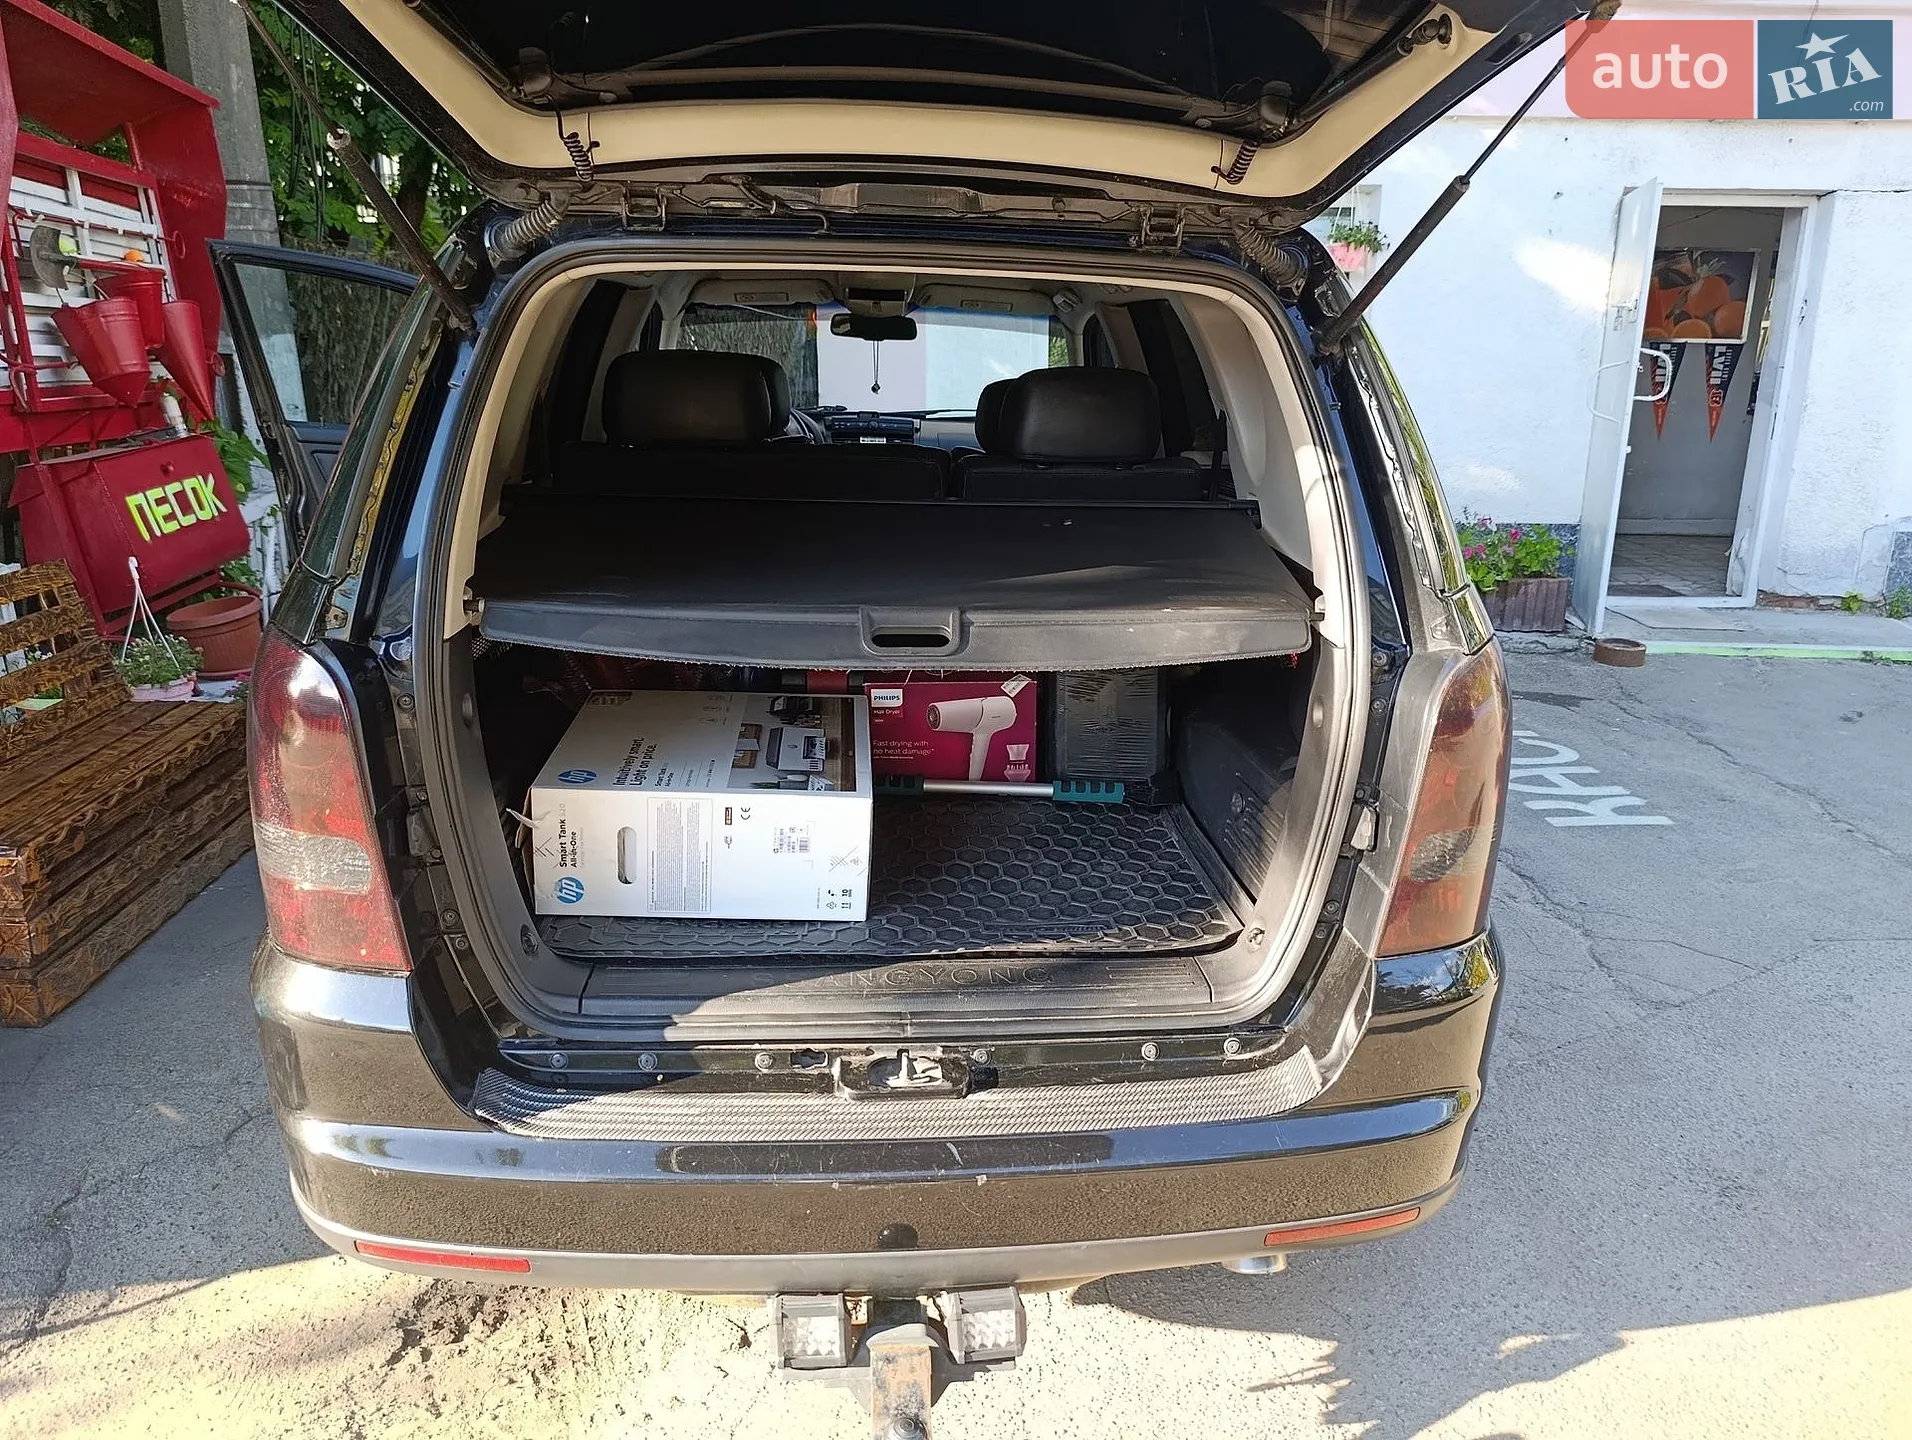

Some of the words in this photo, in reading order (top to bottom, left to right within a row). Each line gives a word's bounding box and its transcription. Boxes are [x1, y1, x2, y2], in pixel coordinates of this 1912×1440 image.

[1710, 346, 1727, 385] LVII
[125, 474, 228, 542] ПЕСОК
[642, 744, 657, 760] price.
[889, 740, 913, 748] drying
[613, 754, 638, 786] Intuitively
[639, 760, 650, 769] on
[557, 769, 597, 784] hp
[629, 769, 647, 786] Light
[1509, 730, 1676, 827] КАС
[559, 819, 567, 840] Tank
[559, 841, 568, 868] Smart
[557, 877, 585, 904] hp
[751, 967, 1055, 987] SANGYONG
